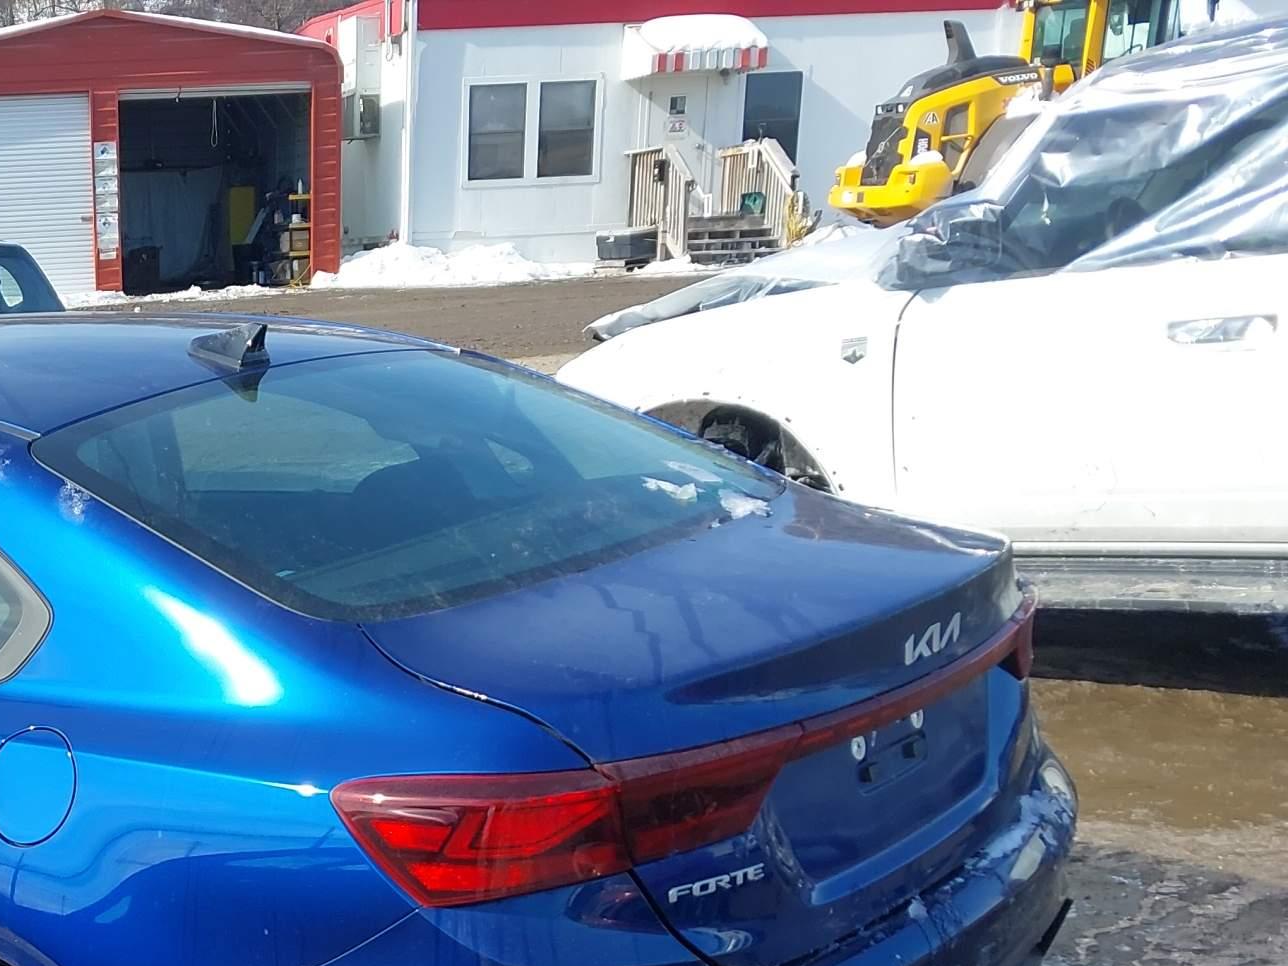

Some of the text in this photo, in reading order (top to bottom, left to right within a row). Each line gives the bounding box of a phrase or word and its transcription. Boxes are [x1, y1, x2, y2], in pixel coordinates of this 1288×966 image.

[998, 73, 1038, 83] VOLVO
[904, 612, 960, 666] KIA
[668, 863, 764, 904] FORTE
